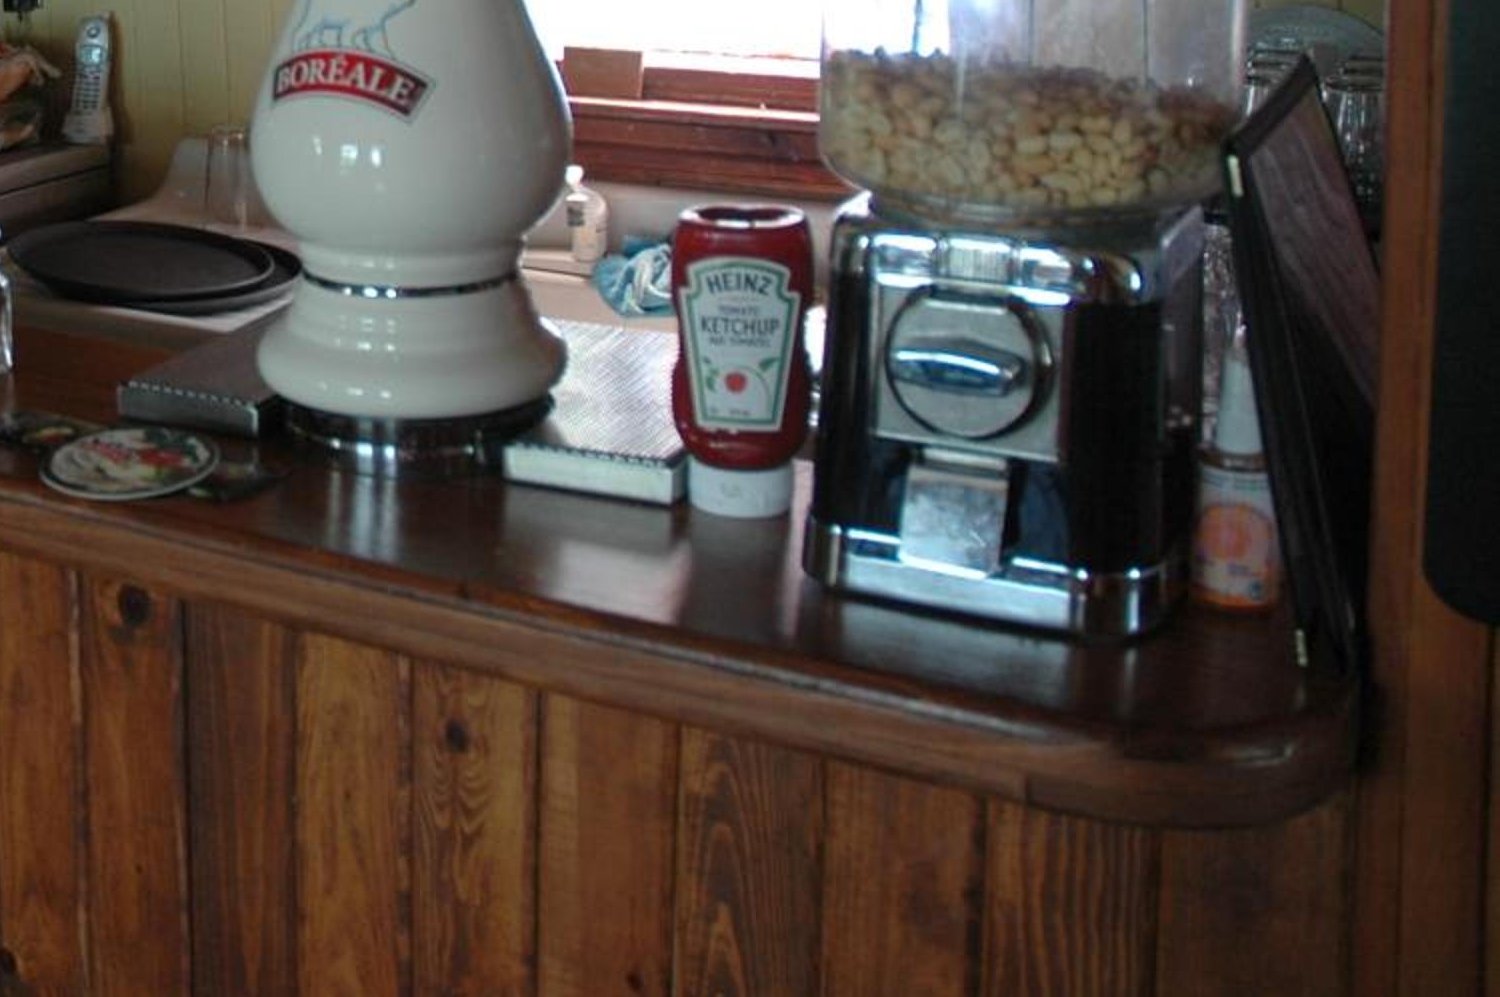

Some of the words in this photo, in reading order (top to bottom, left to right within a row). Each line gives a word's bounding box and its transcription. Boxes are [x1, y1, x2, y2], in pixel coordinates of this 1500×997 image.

[276, 52, 415, 103] BORÉALE
[706, 272, 772, 297] HEINZ
[700, 315, 780, 336] KETCHUP
